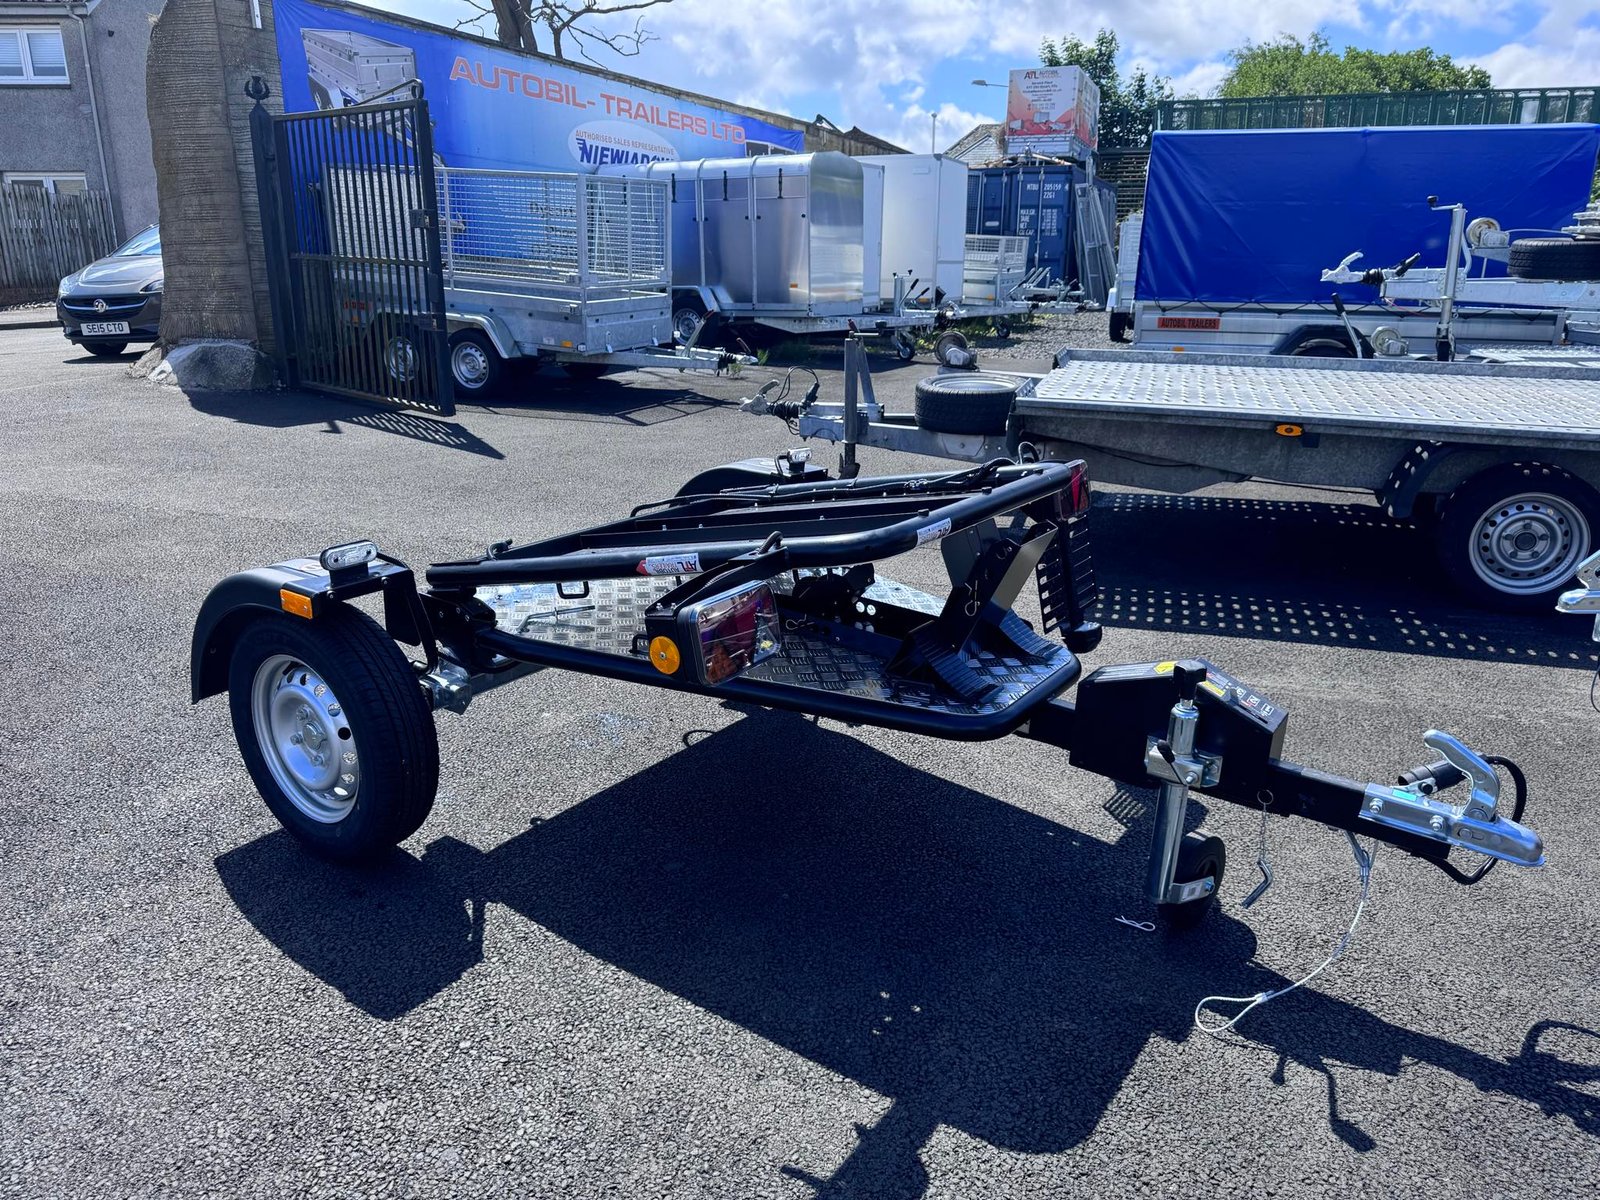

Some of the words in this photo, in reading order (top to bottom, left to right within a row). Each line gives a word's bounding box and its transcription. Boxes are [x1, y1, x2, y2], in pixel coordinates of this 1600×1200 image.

[600, 93, 708, 136] TRAILERS
[711, 121, 746, 144] LTD
[575, 129, 613, 144] AUTHORISED
[613, 137, 631, 148] SALES
[631, 140, 674, 156] REPRESENTATIVE
[86, 324, 105, 333] SE15
[106, 323, 124, 333] CTO
[1160, 318, 1186, 328] AUTOBIL
[1188, 318, 1217, 329] TRAILERS
[677, 560, 697, 572] ATL
